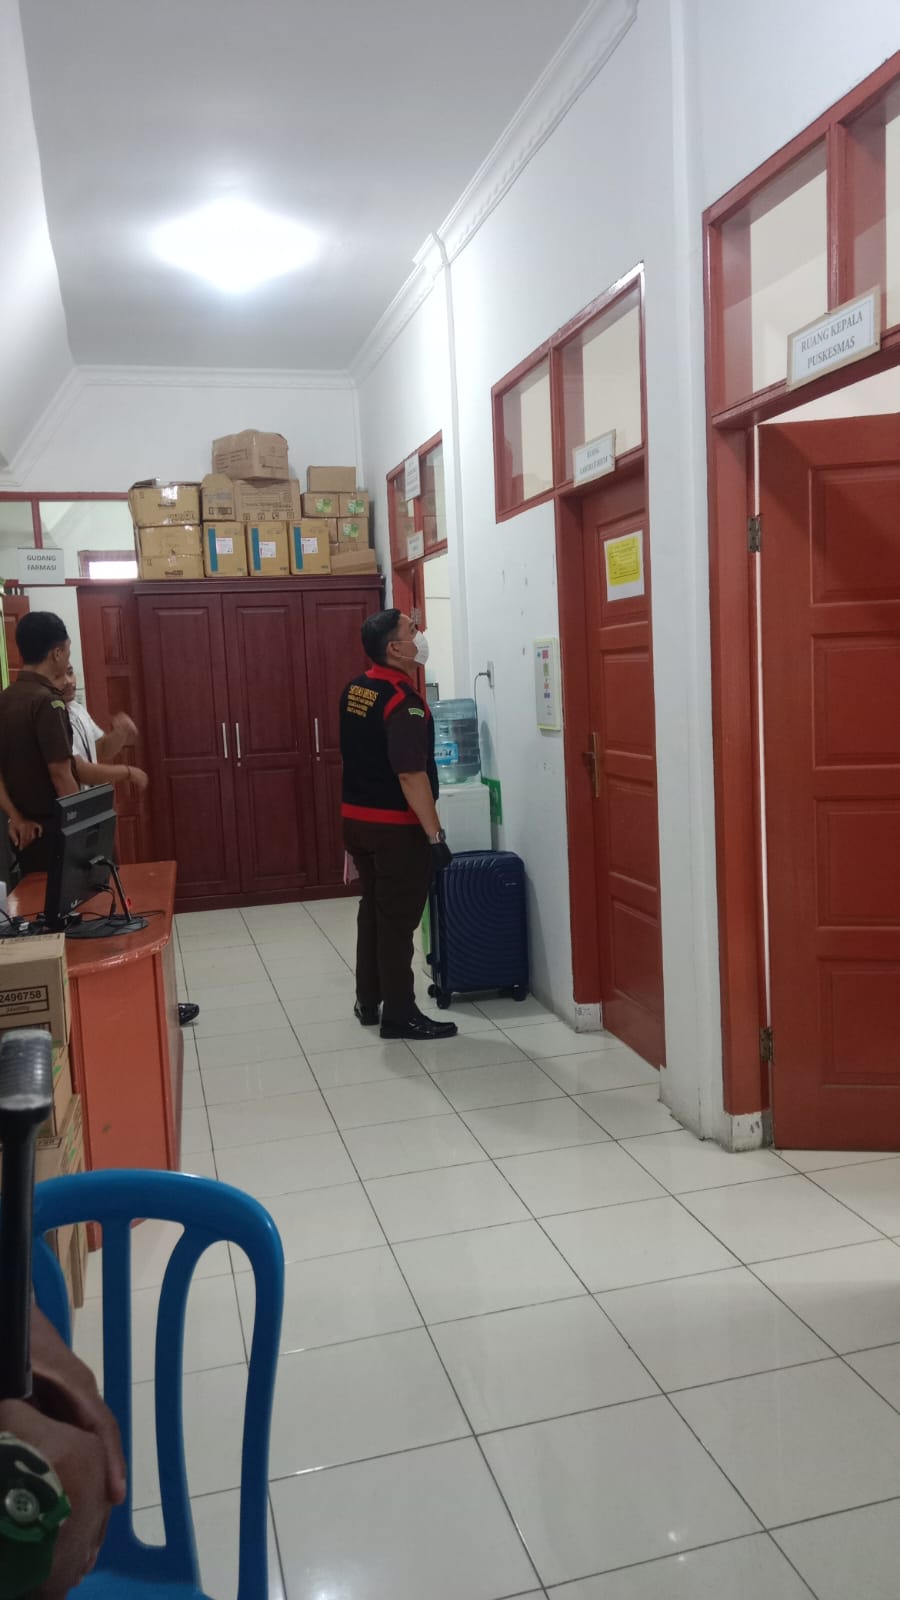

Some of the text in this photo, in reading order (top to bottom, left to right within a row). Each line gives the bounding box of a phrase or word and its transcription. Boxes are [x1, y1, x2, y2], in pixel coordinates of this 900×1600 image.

[801, 311, 863, 353] RUANG KEPALA
[807, 335, 855, 369] PUSKESMAS
